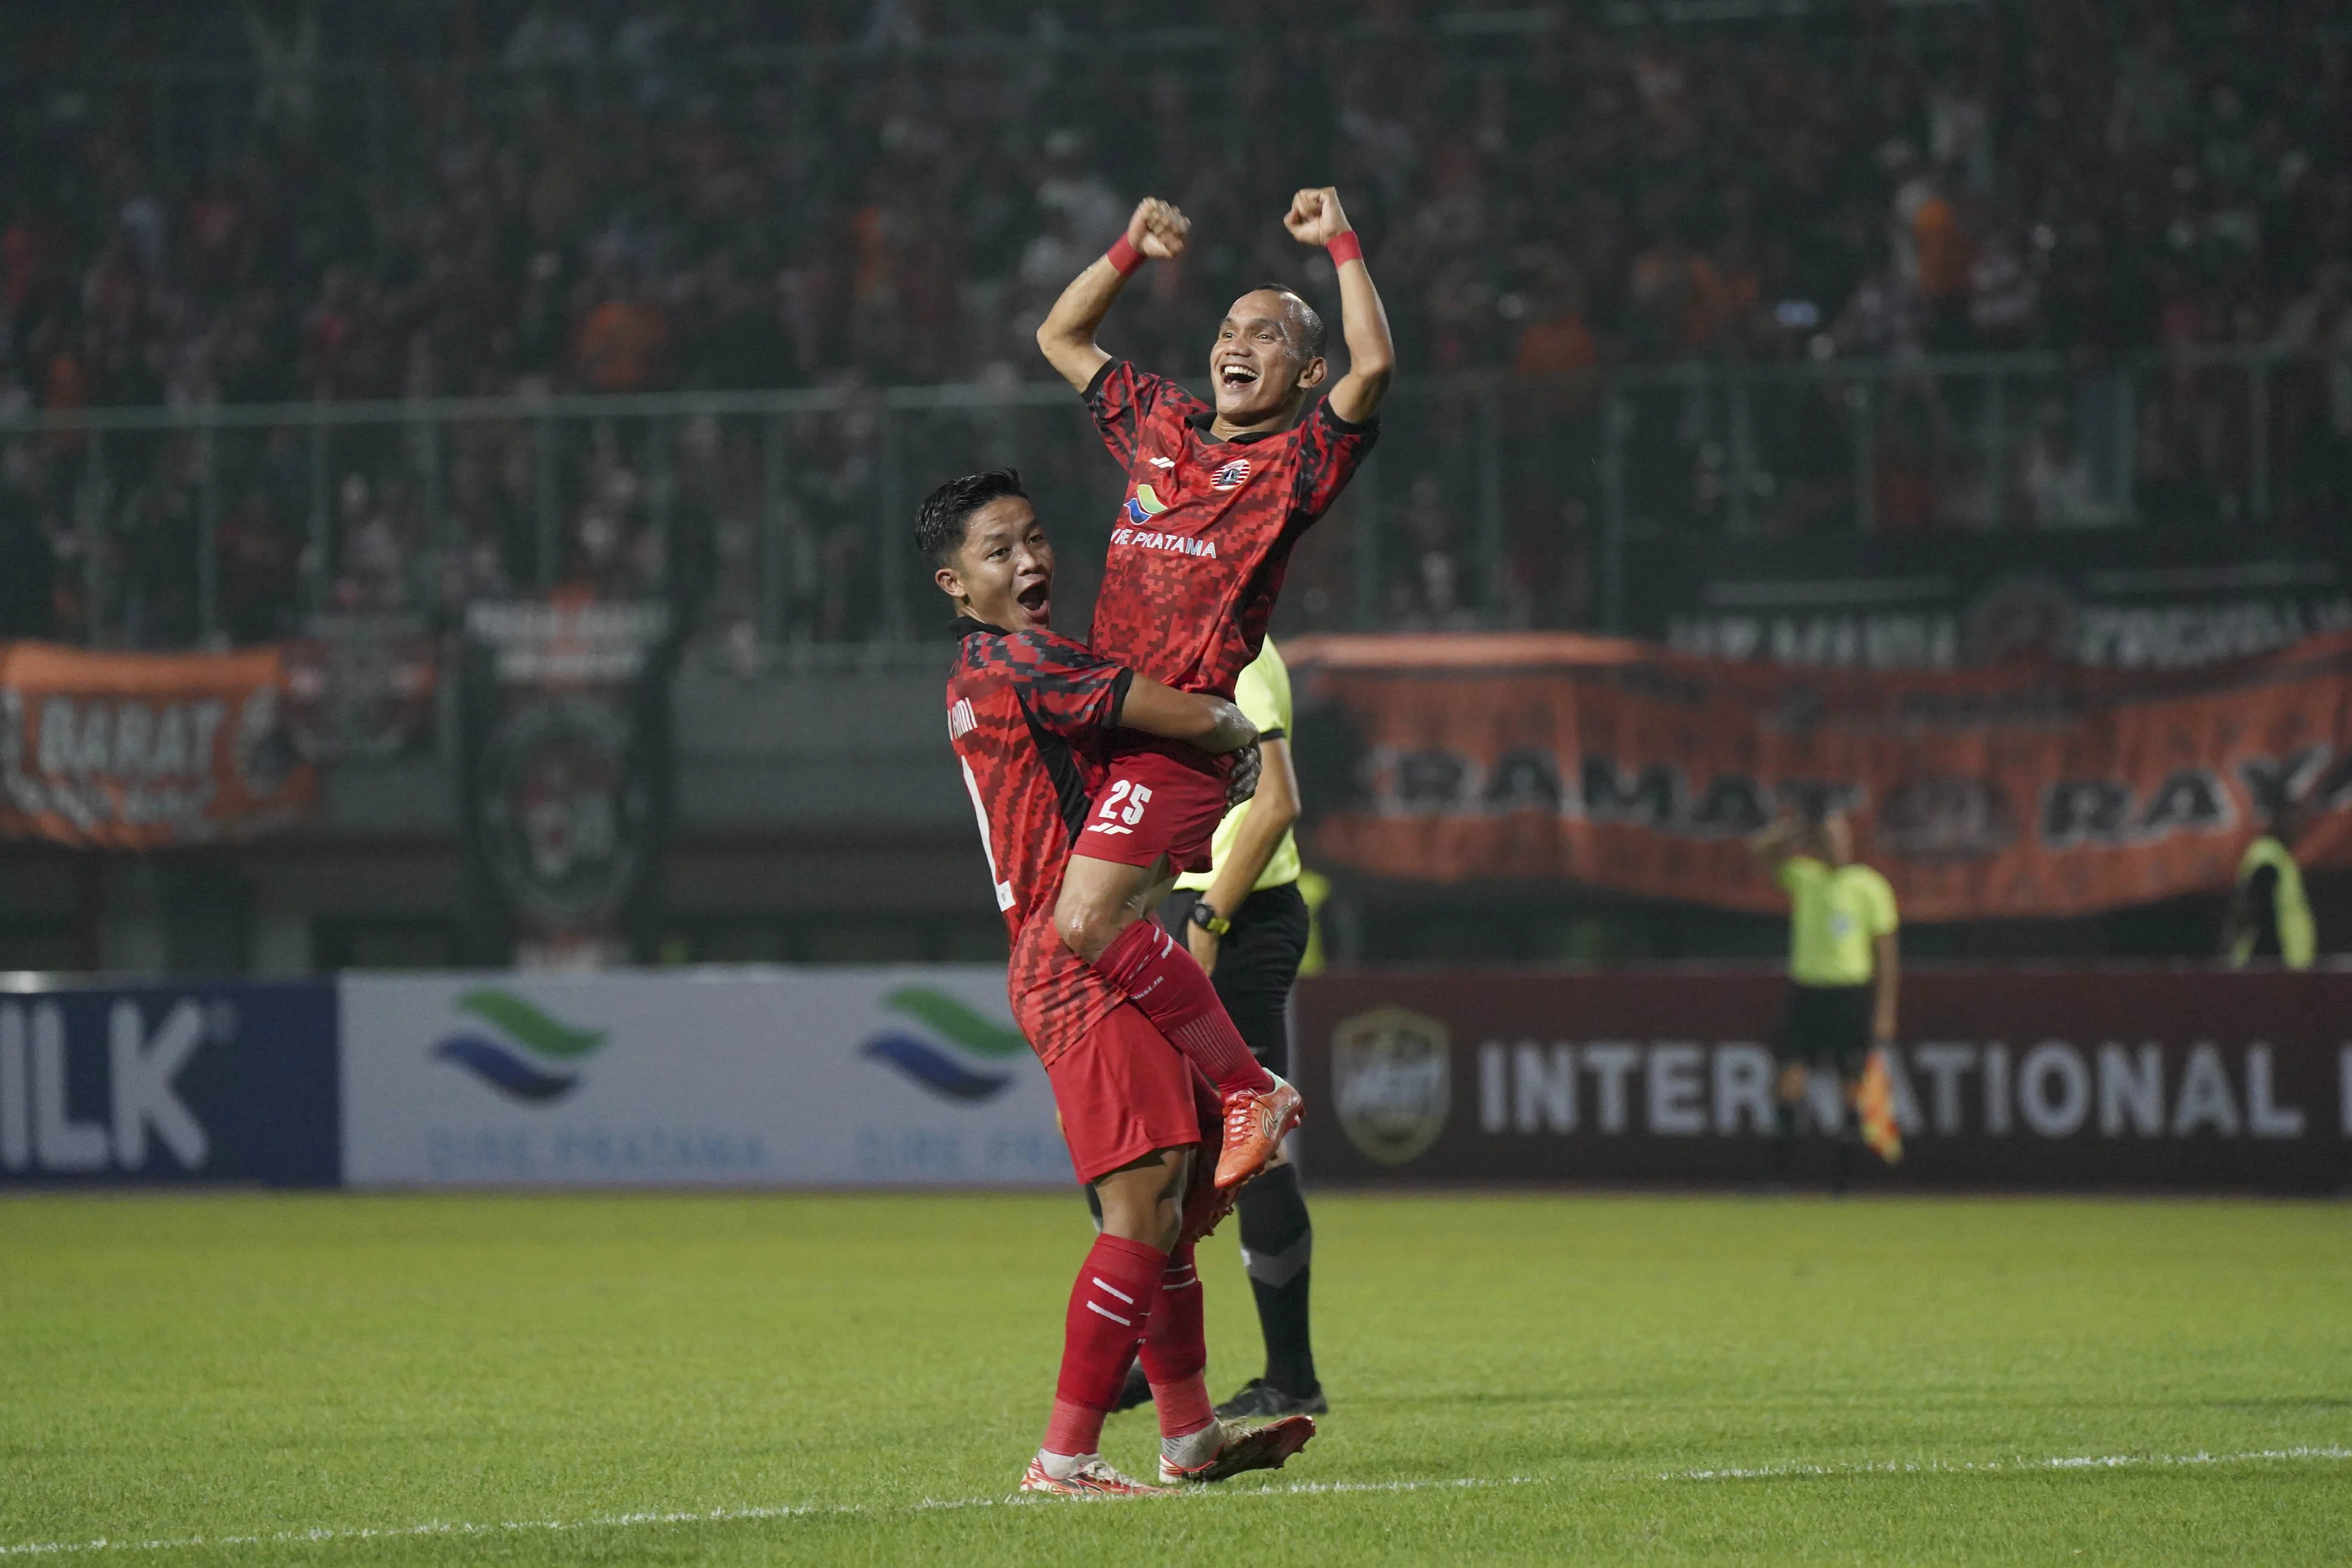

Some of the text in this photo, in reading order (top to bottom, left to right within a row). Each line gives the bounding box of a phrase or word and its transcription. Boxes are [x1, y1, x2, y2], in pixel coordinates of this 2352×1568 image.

[1131, 531, 1217, 559] PRATAMA
[1098, 779, 1153, 826] 25
[1359, 744, 1872, 846] RAMAT
